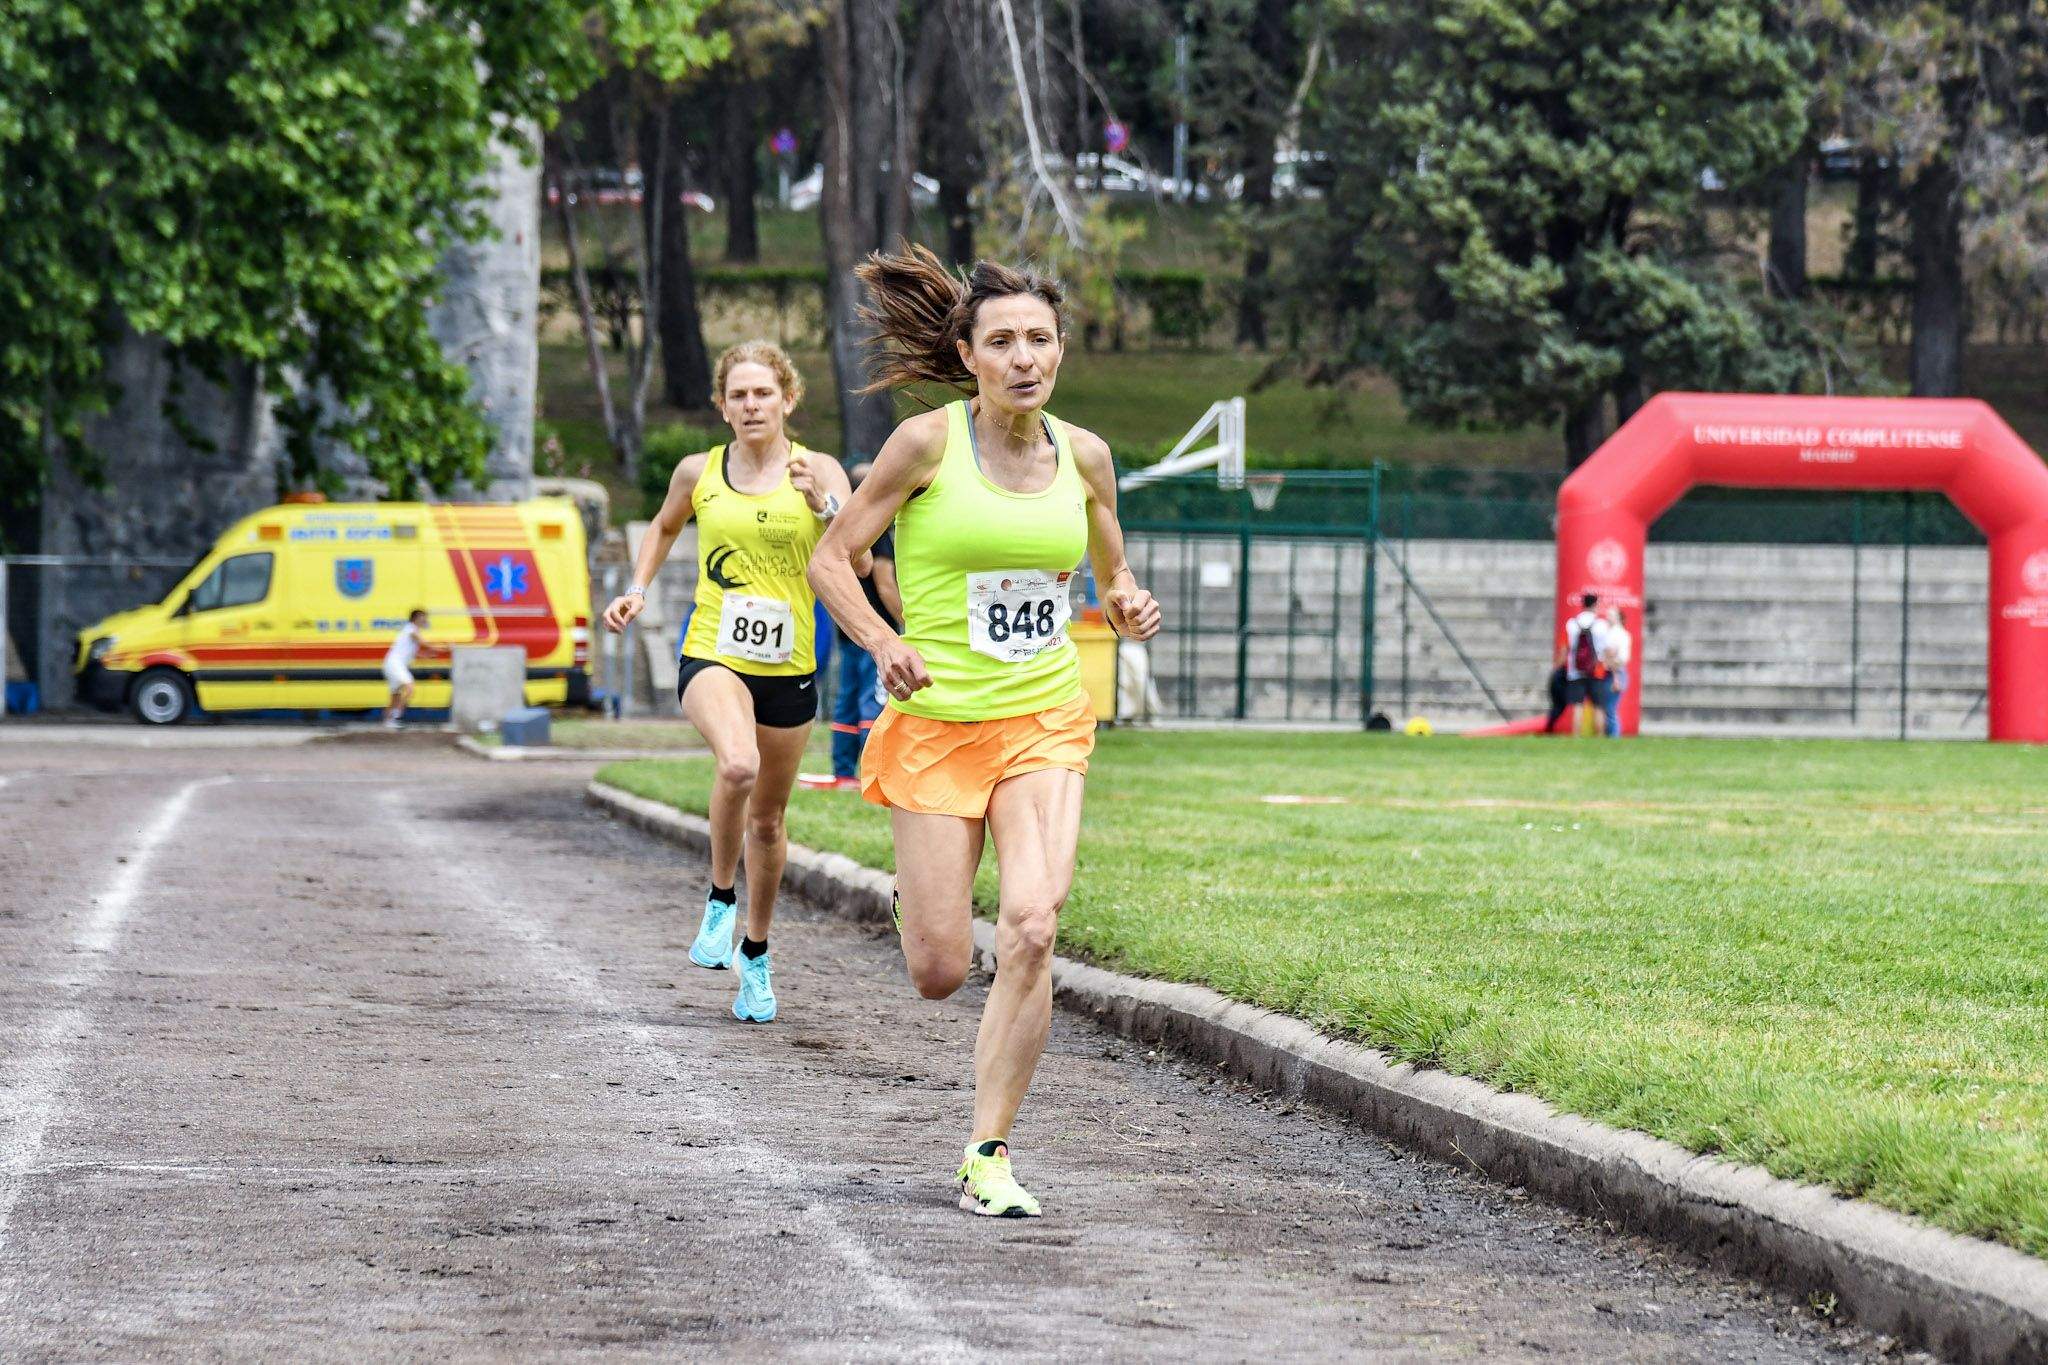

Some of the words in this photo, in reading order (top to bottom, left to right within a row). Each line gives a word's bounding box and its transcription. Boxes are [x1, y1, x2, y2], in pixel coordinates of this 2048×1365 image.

[1693, 426, 1821, 446] UNIVERSIDAD
[1827, 427, 1963, 449] COMPLUTENSE
[732, 616, 784, 649] 891
[988, 599, 1055, 643] 848
